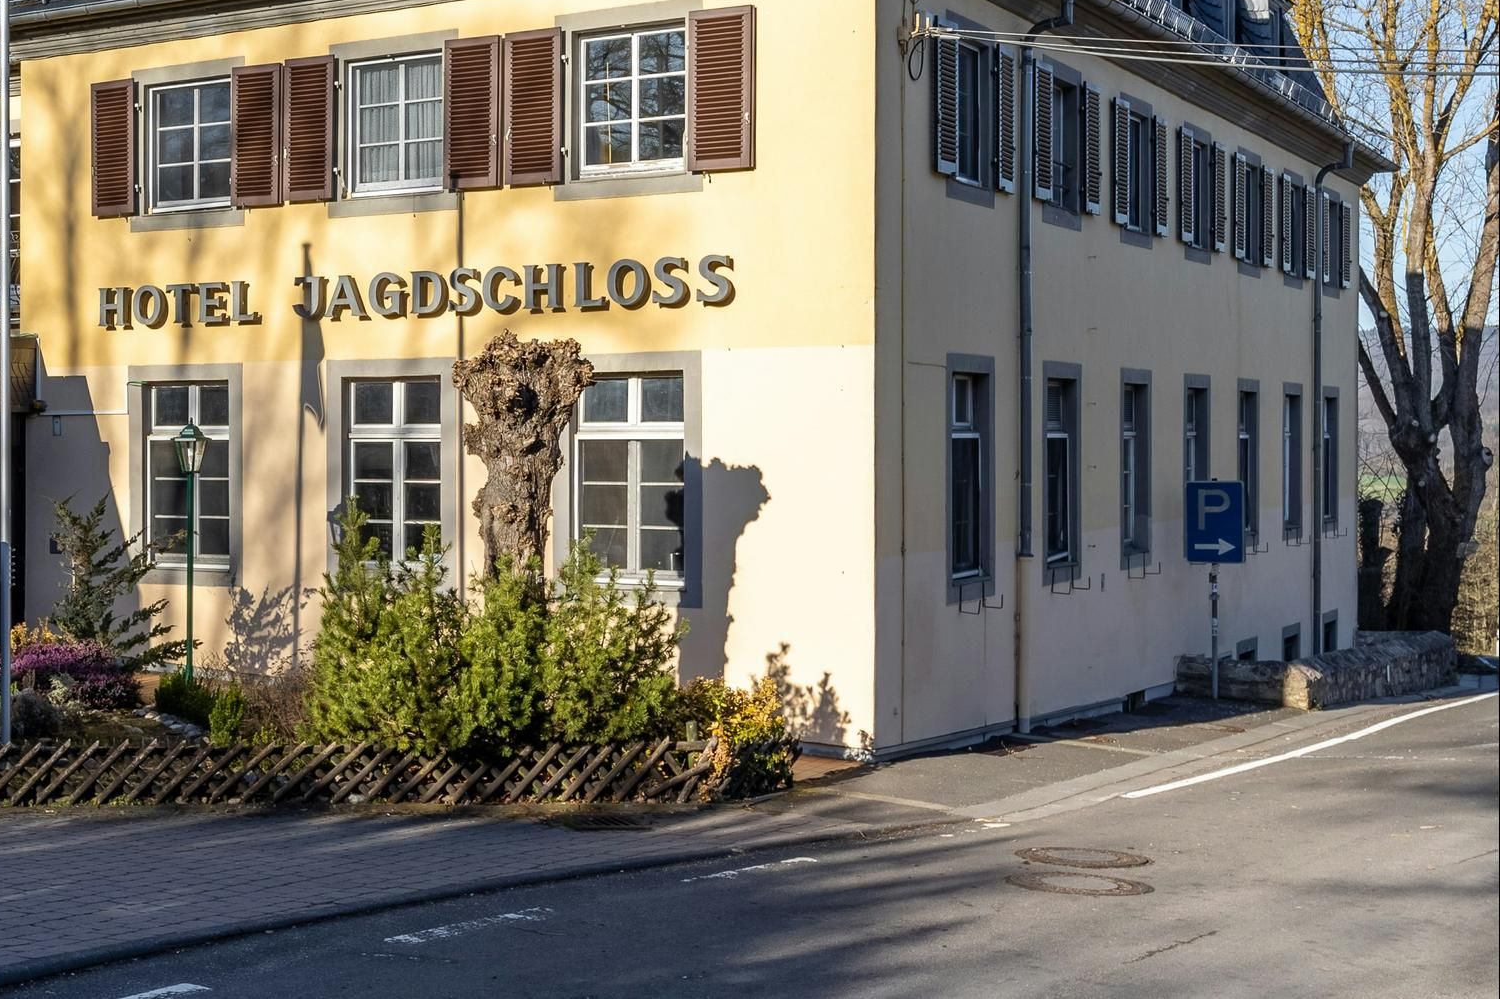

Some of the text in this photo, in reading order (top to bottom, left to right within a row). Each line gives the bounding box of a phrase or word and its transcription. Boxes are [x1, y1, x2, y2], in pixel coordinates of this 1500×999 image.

[98, 255, 735, 330] HOTEL JAGDSCHLOSS
[1198, 489, 1231, 530] P
